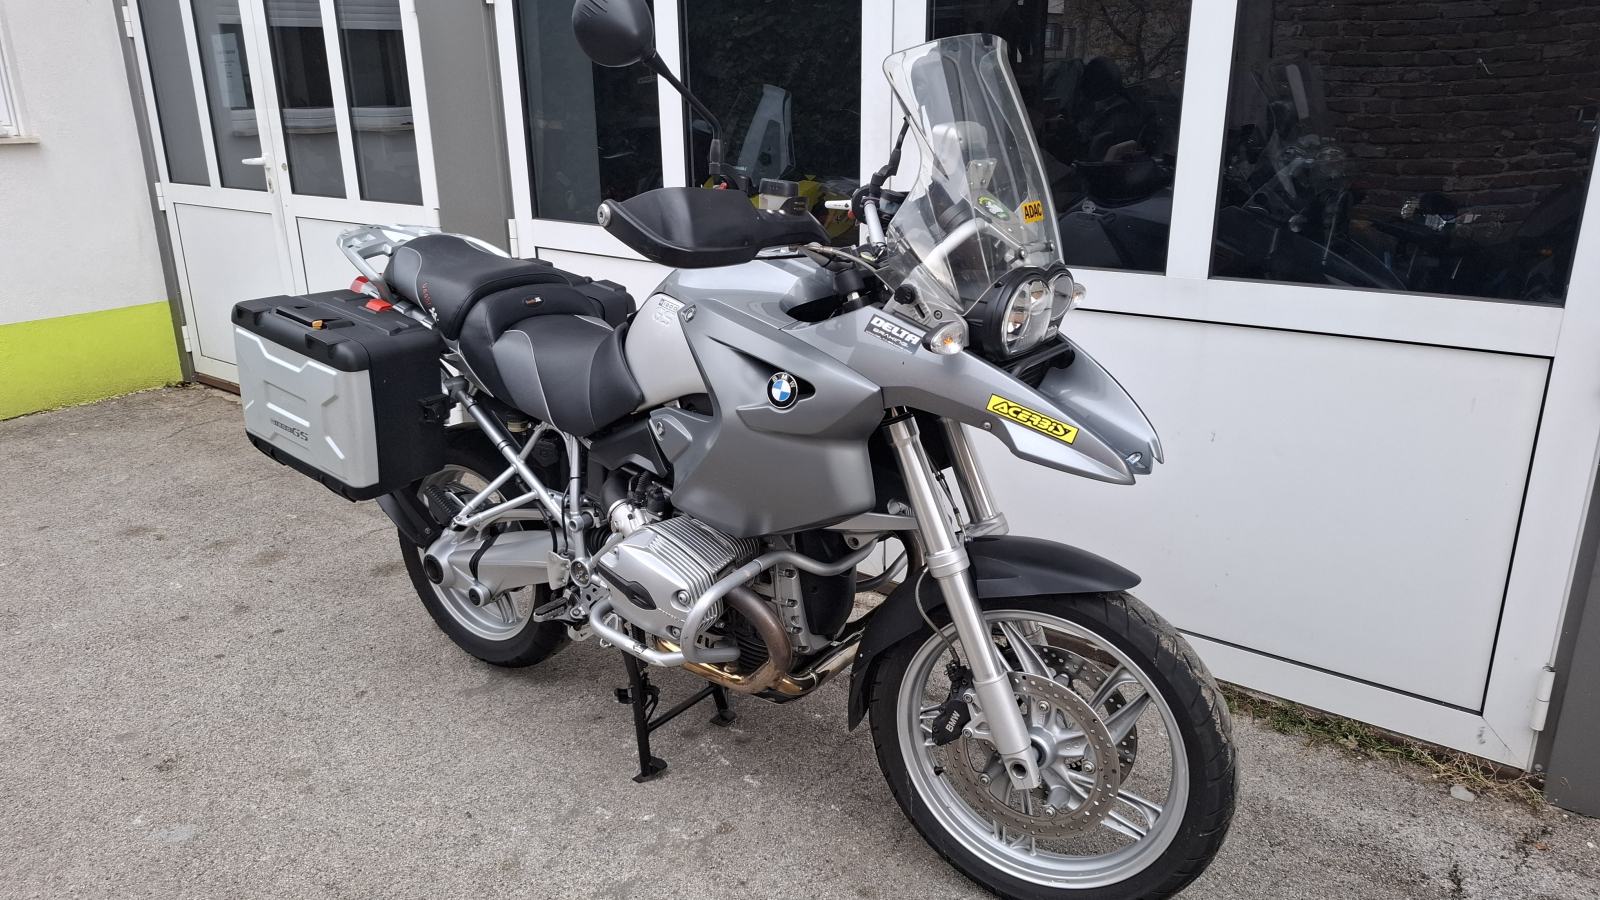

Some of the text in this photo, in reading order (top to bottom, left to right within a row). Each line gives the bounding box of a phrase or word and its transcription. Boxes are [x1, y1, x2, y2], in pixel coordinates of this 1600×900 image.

[1024, 203, 1042, 220] ADAC
[870, 316, 921, 345] DELTA
[771, 373, 796, 388] BMW
[945, 710, 960, 733] BMW
